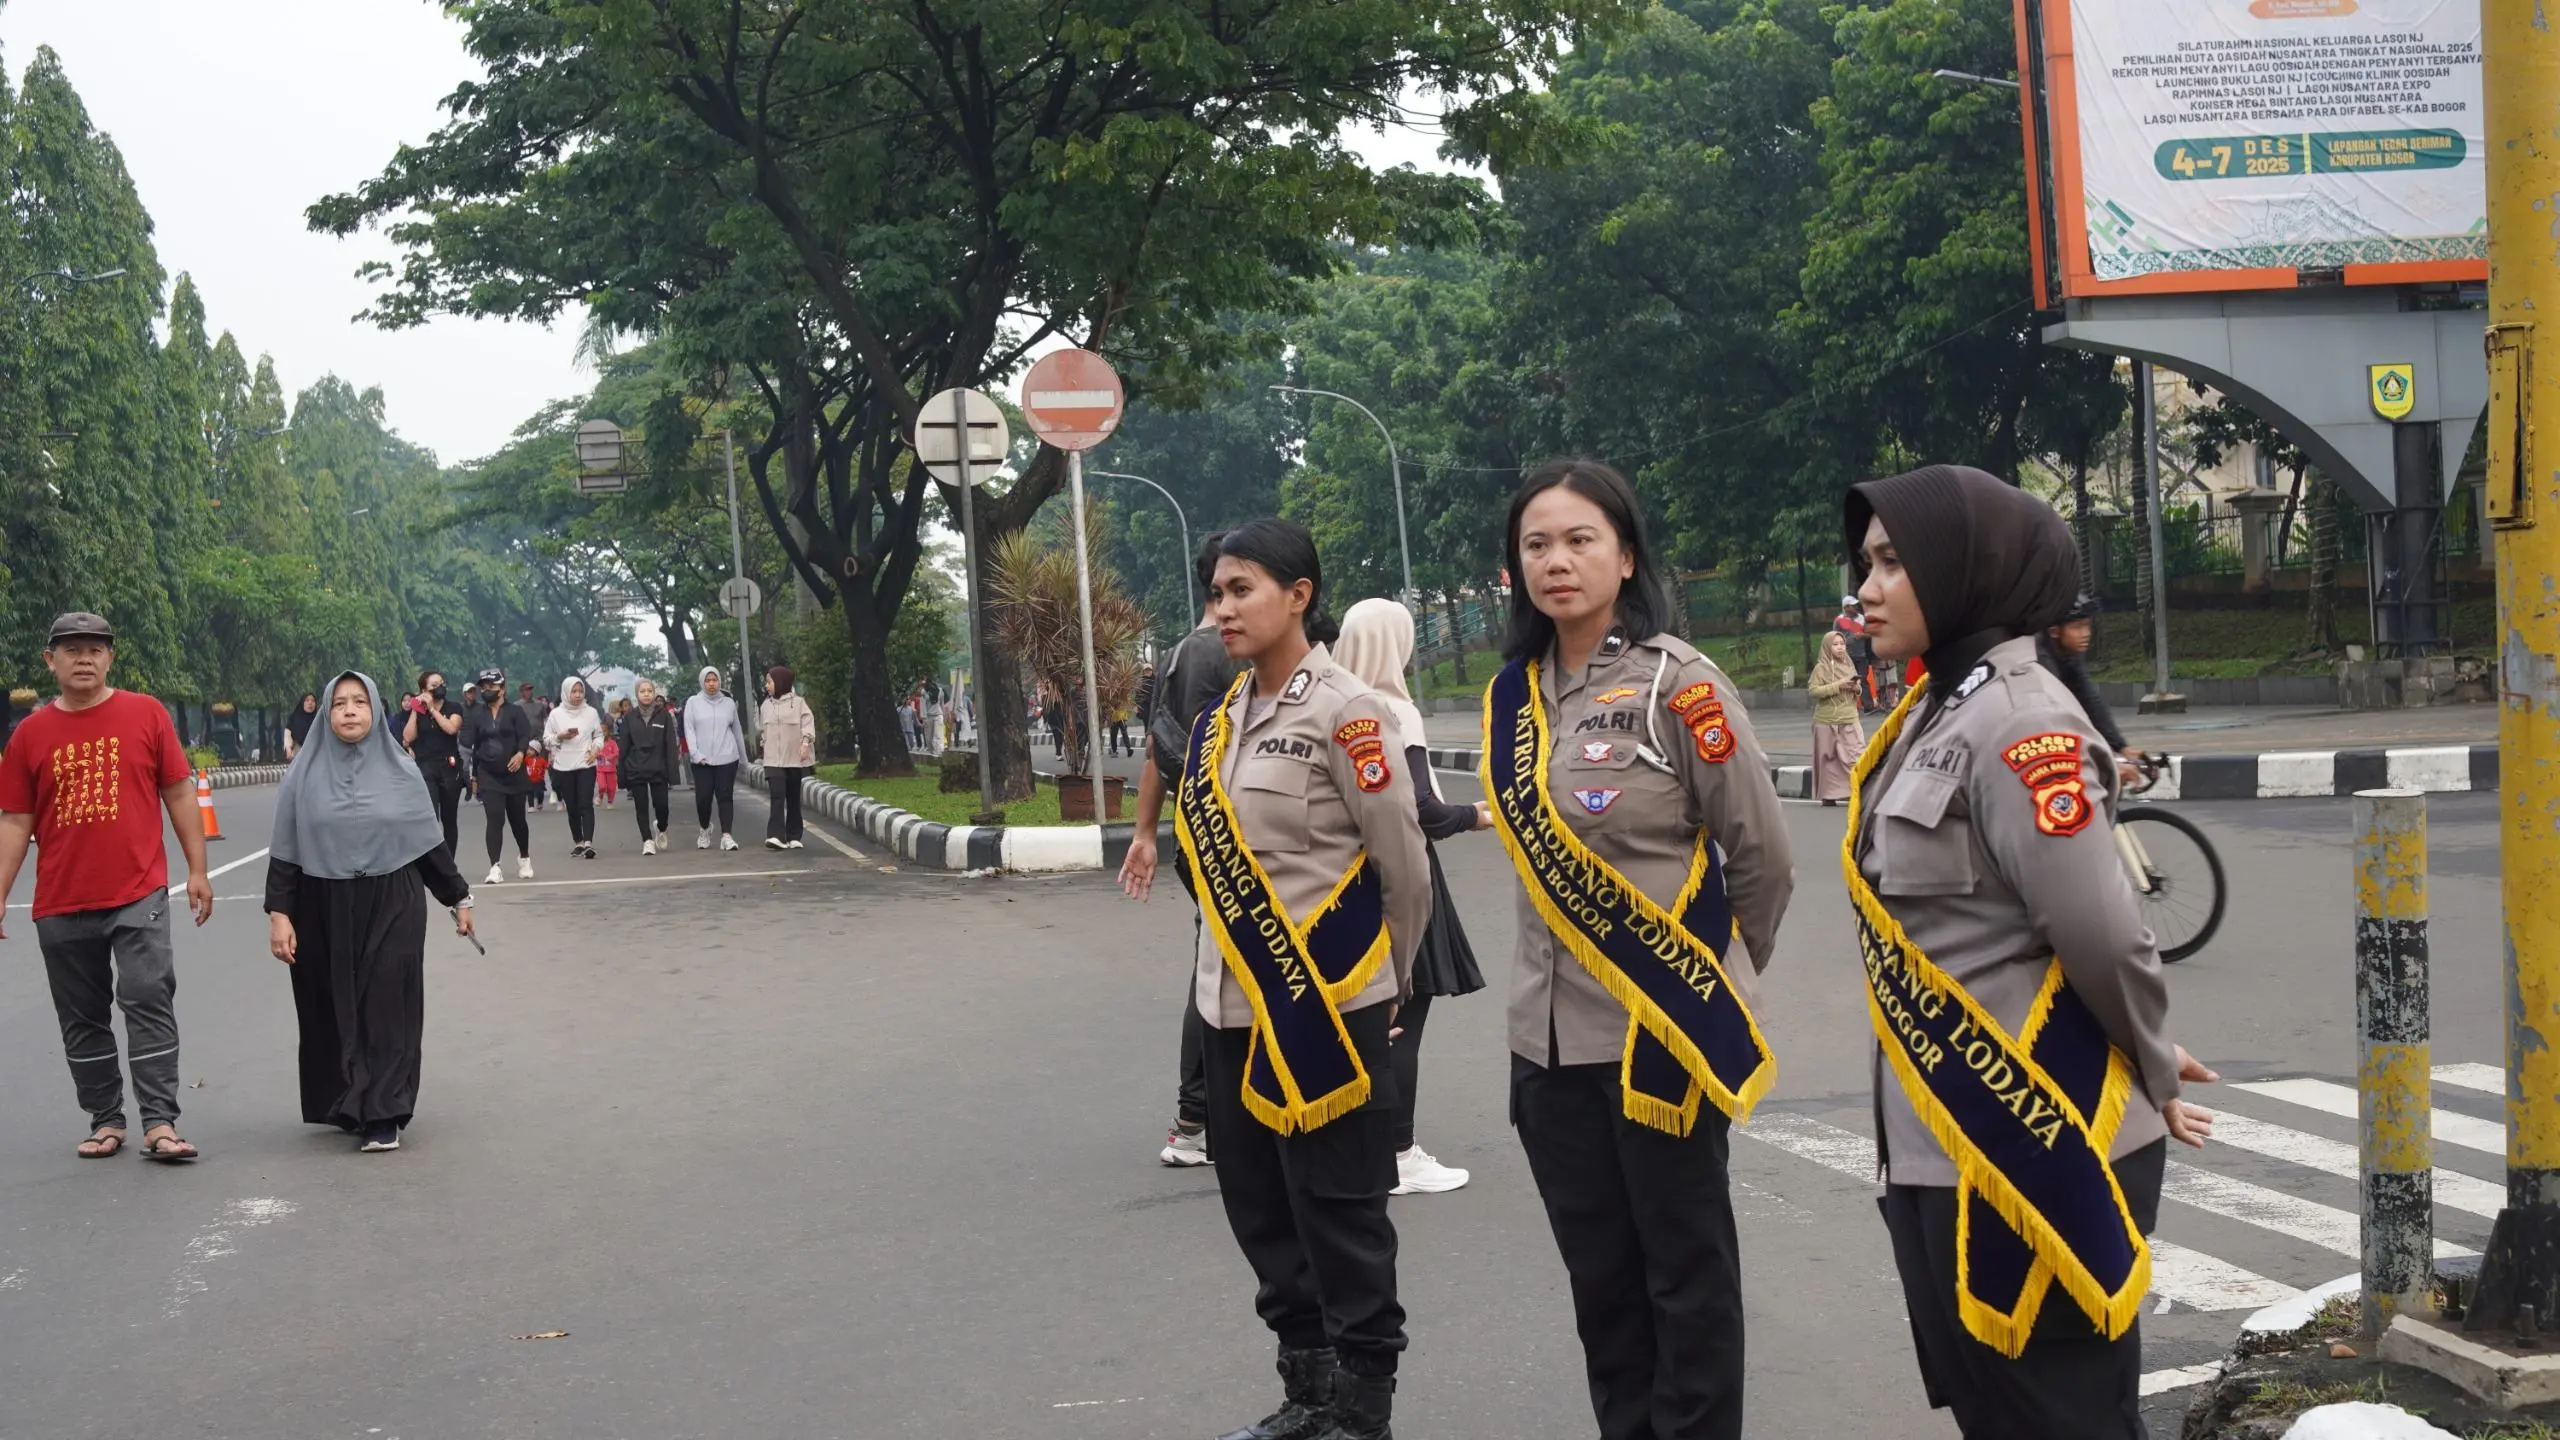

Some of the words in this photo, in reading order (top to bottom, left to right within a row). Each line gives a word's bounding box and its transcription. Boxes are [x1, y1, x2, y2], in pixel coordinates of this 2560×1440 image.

[2178, 40, 2252, 52] SILATURAHMI
[2254, 36, 2311, 48] NASIONAL
[2314, 35, 2372, 46] KELUARGA
[2409, 32, 2424, 43] NJ
[2123, 54, 2182, 66] PEMILIHAN
[2184, 52, 2215, 62] DUTA
[2269, 46, 2337, 60] NUSANTARA
[2340, 46, 2388, 57] TINGKAT
[2390, 44, 2444, 56] NASIONAL
[2448, 42, 2473, 53] 2025
[2112, 67, 2149, 78] REKOR
[2151, 66, 2178, 76] MURI
[2180, 64, 2238, 76] MENYANYI
[2240, 62, 2270, 73] LAGU
[2322, 58, 2366, 70] DENGAN
[2368, 56, 2424, 68] PENYANYI
[2155, 76, 2218, 88] LAUNCHING
[2221, 74, 2250, 86] BUKU
[2288, 72, 2303, 82] NJ
[2310, 70, 2364, 82] COUCHING
[2366, 68, 2401, 80] KLINIK
[2172, 88, 2230, 100] RAPIMNAS
[2268, 86, 2282, 96] NJ
[2332, 80, 2400, 92] NUSANTARA
[2402, 80, 2431, 90] EXPO
[2190, 99, 2234, 111] KONSER
[2236, 98, 2267, 109] MEGA
[2269, 96, 2318, 108] BINTANG
[2354, 92, 2422, 105] NUSANTARA
[2144, 114, 2177, 125] LASQI
[2180, 110, 2248, 123] NUSANTARA
[2252, 108, 2304, 120] BERSAMA
[2307, 107, 2337, 118] PARA
[2340, 105, 2386, 116] DIFABEL
[2388, 104, 2428, 115] SE-KAB
[2431, 102, 2466, 113] BOGOR
[2246, 158, 2290, 174] 2025
[1338, 720, 1376, 739] POLRES
[1575, 711, 1634, 734] POLRI
[1256, 738, 1312, 760] POLRI
[2008, 736, 2075, 760] POLRES
[1912, 748, 1962, 774] POLRI
[1184, 776, 1210, 852] POLRES
[1202, 850, 1243, 925] BOGOR
[1514, 703, 1534, 801] PATROLI
[1529, 804, 1620, 909] MOJANG
[1624, 908, 1717, 1002] LODAYA
[1502, 785, 1550, 870] POLRES
[1546, 866, 1614, 942] BOGOR
[1201, 792, 1256, 896] MOJANG
[1249, 901, 1306, 1002] LODAYA
[1876, 979, 1944, 1074] BOGOR
[1948, 1021, 2064, 1151] LODAYA
